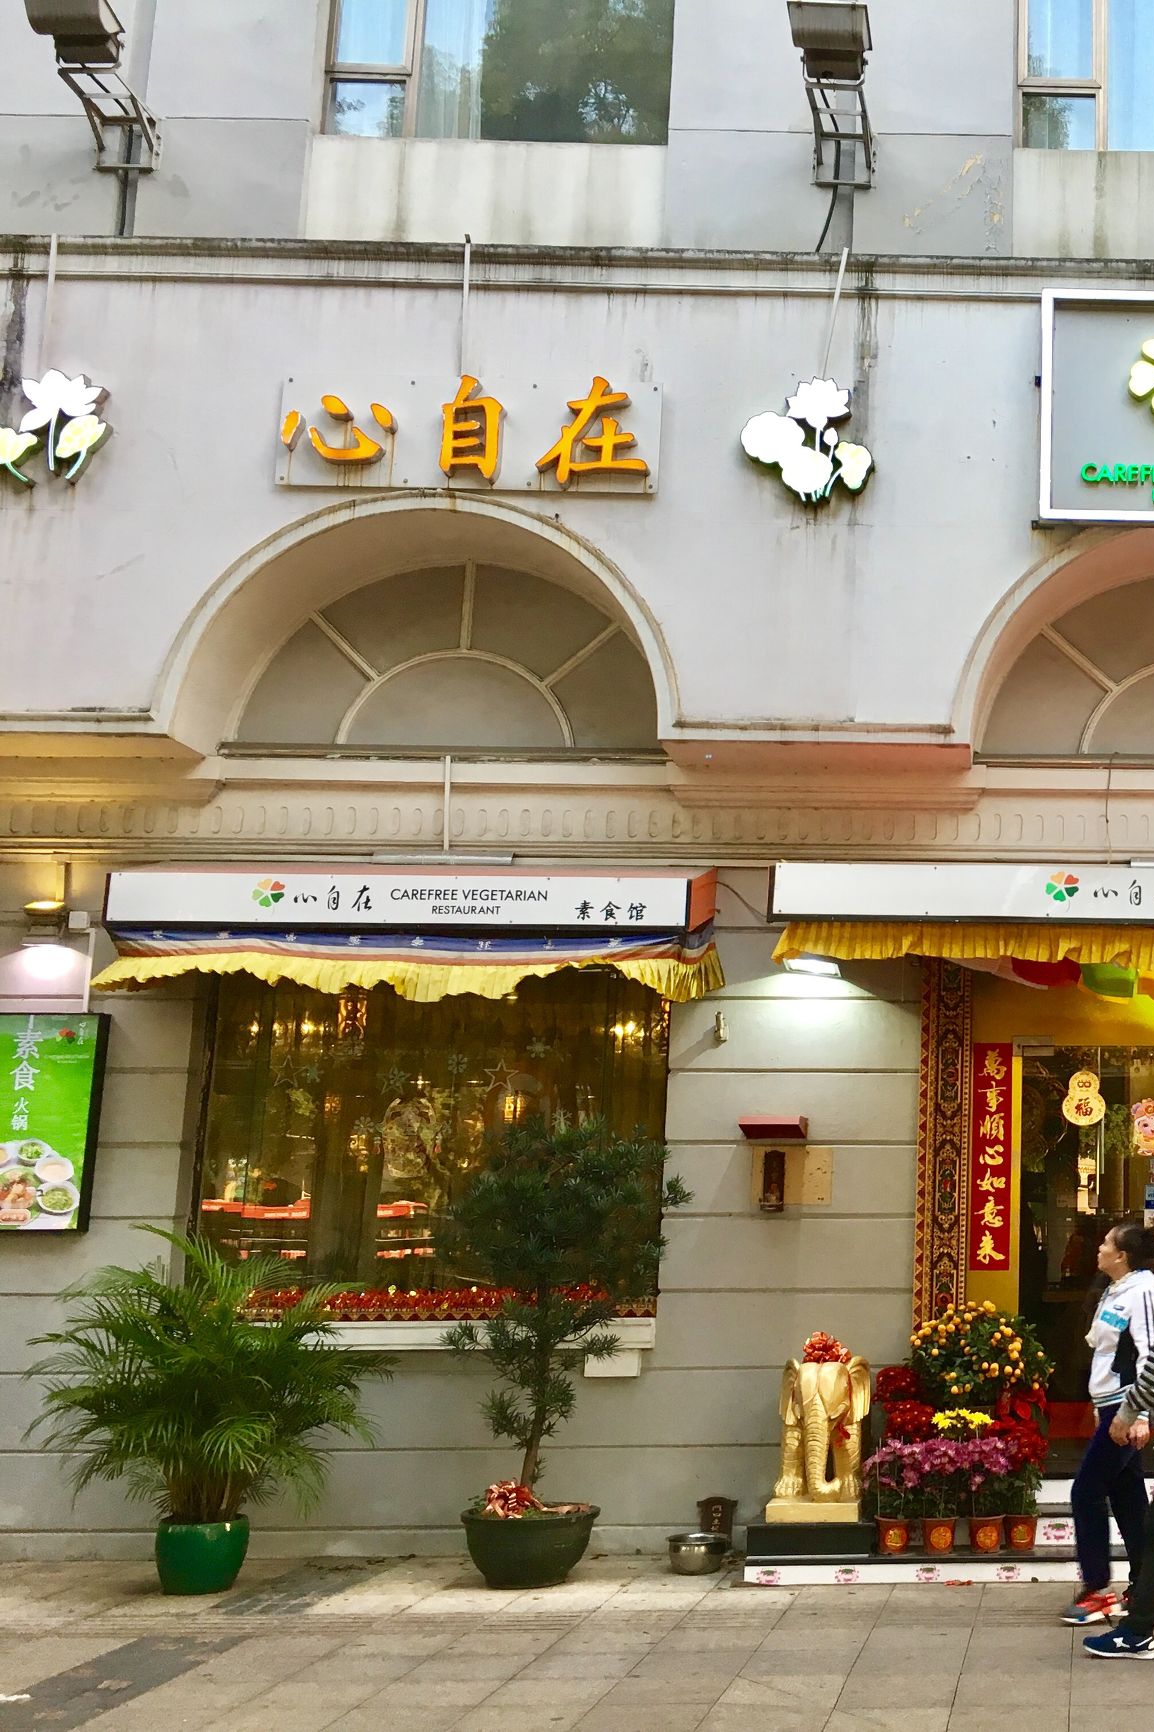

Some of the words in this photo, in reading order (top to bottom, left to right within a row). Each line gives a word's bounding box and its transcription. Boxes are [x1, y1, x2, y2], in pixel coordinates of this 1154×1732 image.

[281, 374, 650, 490] 心自在
[293, 884, 373, 912] 心自在
[390, 888, 458, 901] CAREFREE
[462, 889, 548, 902] VEGETARIAN
[431, 905, 501, 915] RESTAURANT
[574, 900, 647, 921] 素食馆
[10, 1015, 43, 1091] 素食
[10, 1097, 29, 1131] 火锅
